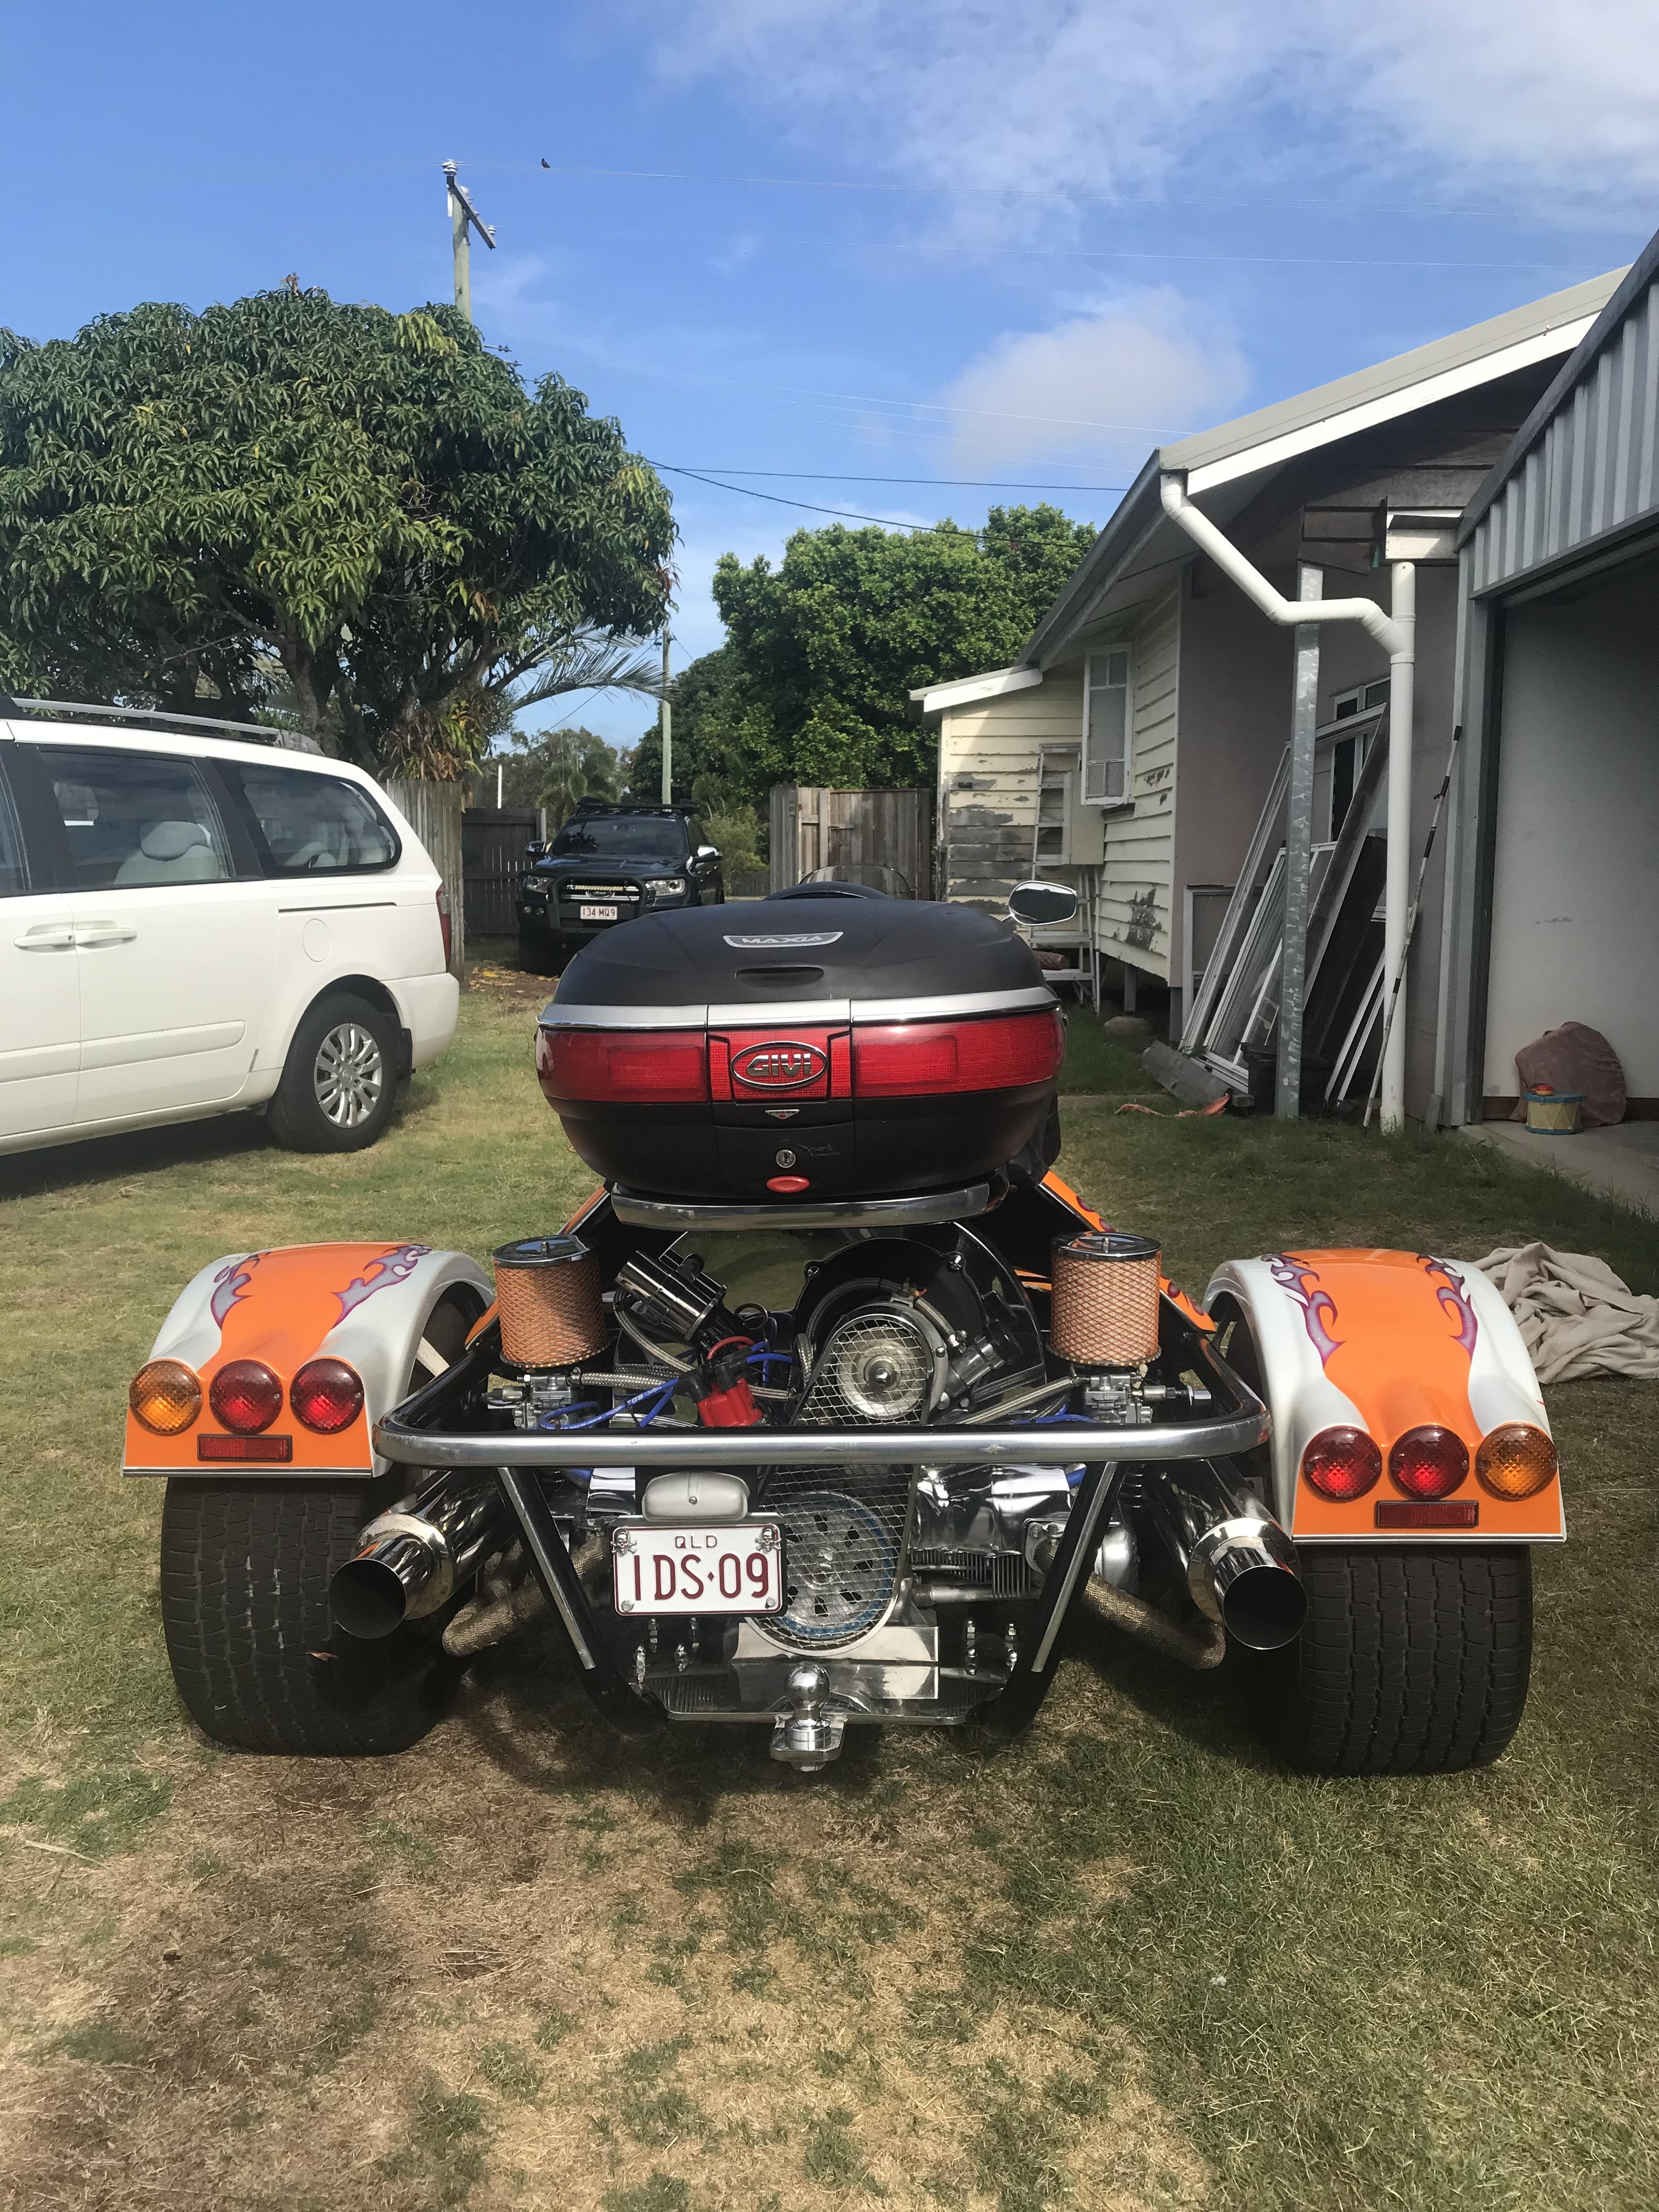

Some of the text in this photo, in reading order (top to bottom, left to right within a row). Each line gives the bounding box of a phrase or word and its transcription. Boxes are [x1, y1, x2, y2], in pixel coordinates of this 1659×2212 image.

[741, 935, 823, 944] MAXIA
[746, 1053, 812, 1076] GIVI
[675, 1535, 718, 1549] QLD
